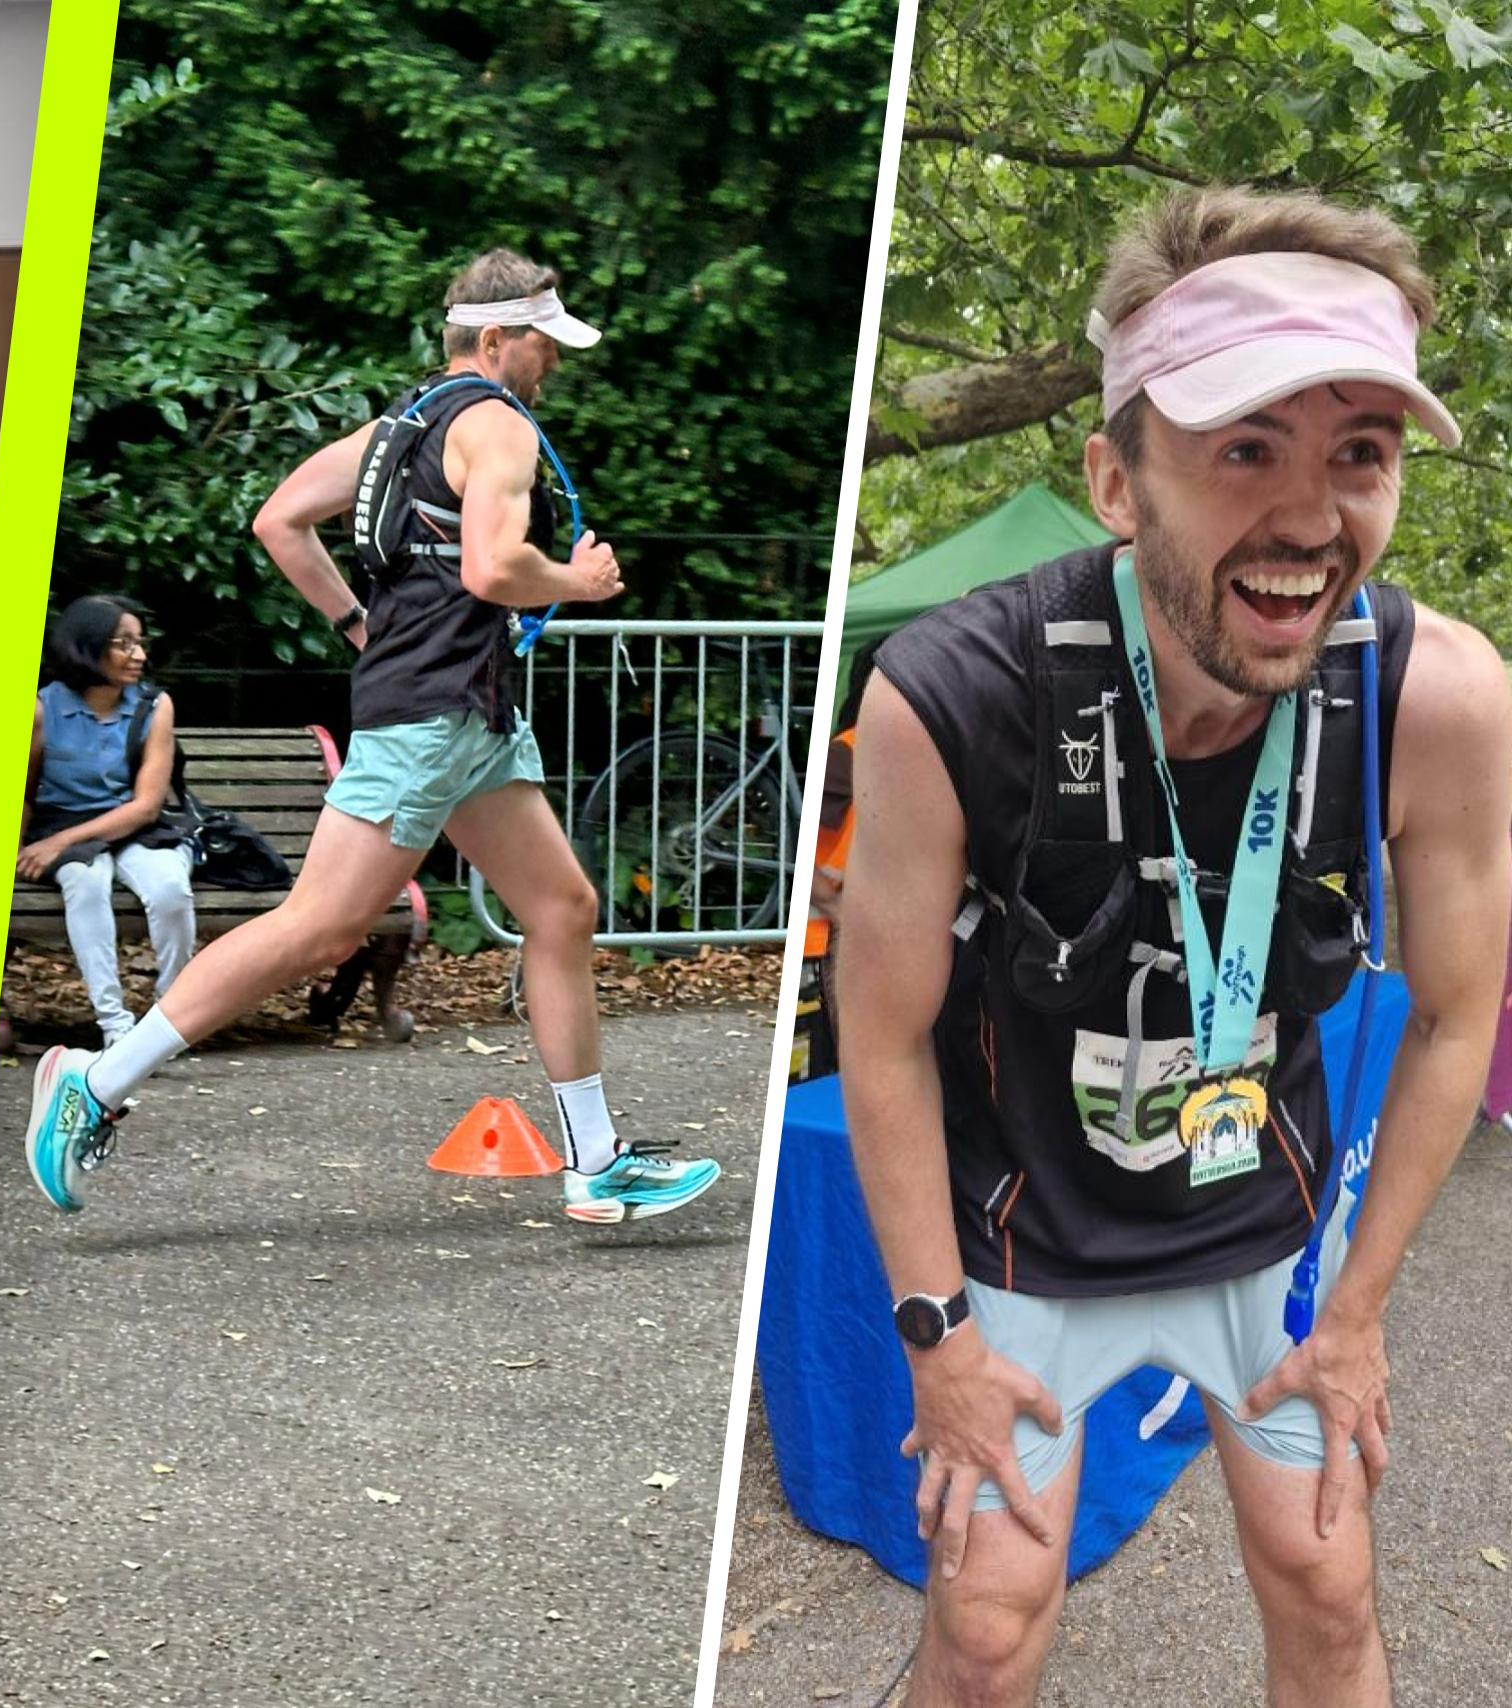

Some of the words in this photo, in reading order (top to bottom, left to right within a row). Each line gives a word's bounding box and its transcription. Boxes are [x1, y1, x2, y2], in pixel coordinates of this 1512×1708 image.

[1132, 647, 1156, 713] 10K
[1058, 782, 1101, 794] UTOBEST
[1247, 786, 1280, 854] 10K
